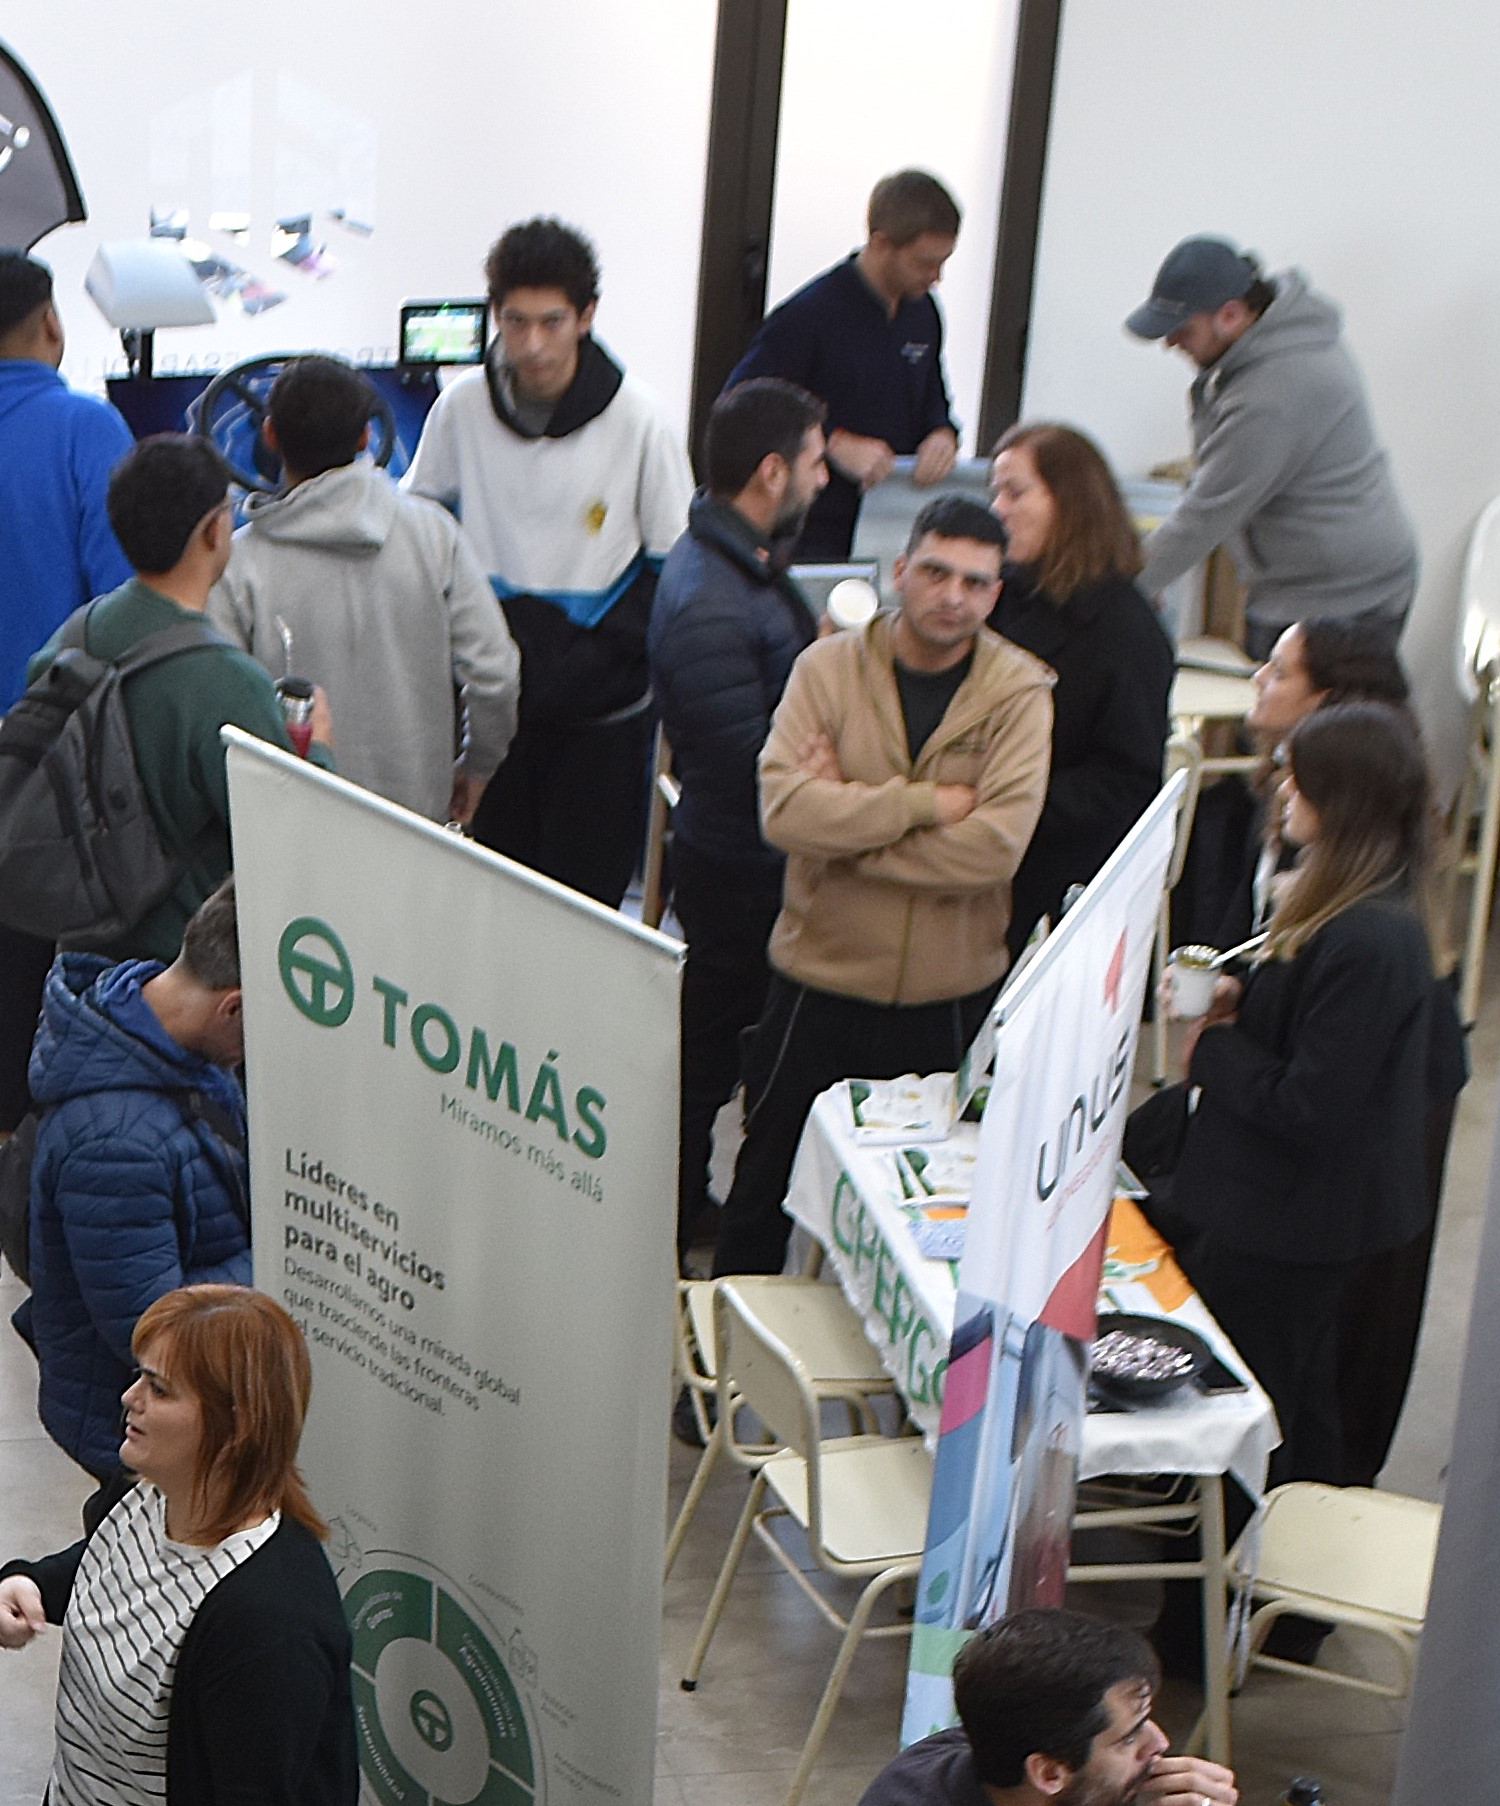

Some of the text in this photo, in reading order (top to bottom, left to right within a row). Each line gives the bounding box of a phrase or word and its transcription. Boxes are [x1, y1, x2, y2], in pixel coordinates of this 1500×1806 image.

[373, 976, 607, 1159] TOMÁS
[285, 1148, 399, 1232] Líderes en
[441, 1094, 603, 1203] Miramos más allá
[284, 1191, 446, 1290] multiservicios
[284, 1224, 415, 1311] para el agro
[284, 1257, 521, 1406] Desarrollamos una mirada global
[284, 1288, 480, 1411] que trasciende las fronteras
[312, 1323, 366, 1367] servicio
[369, 1359, 446, 1417] tradicional.
